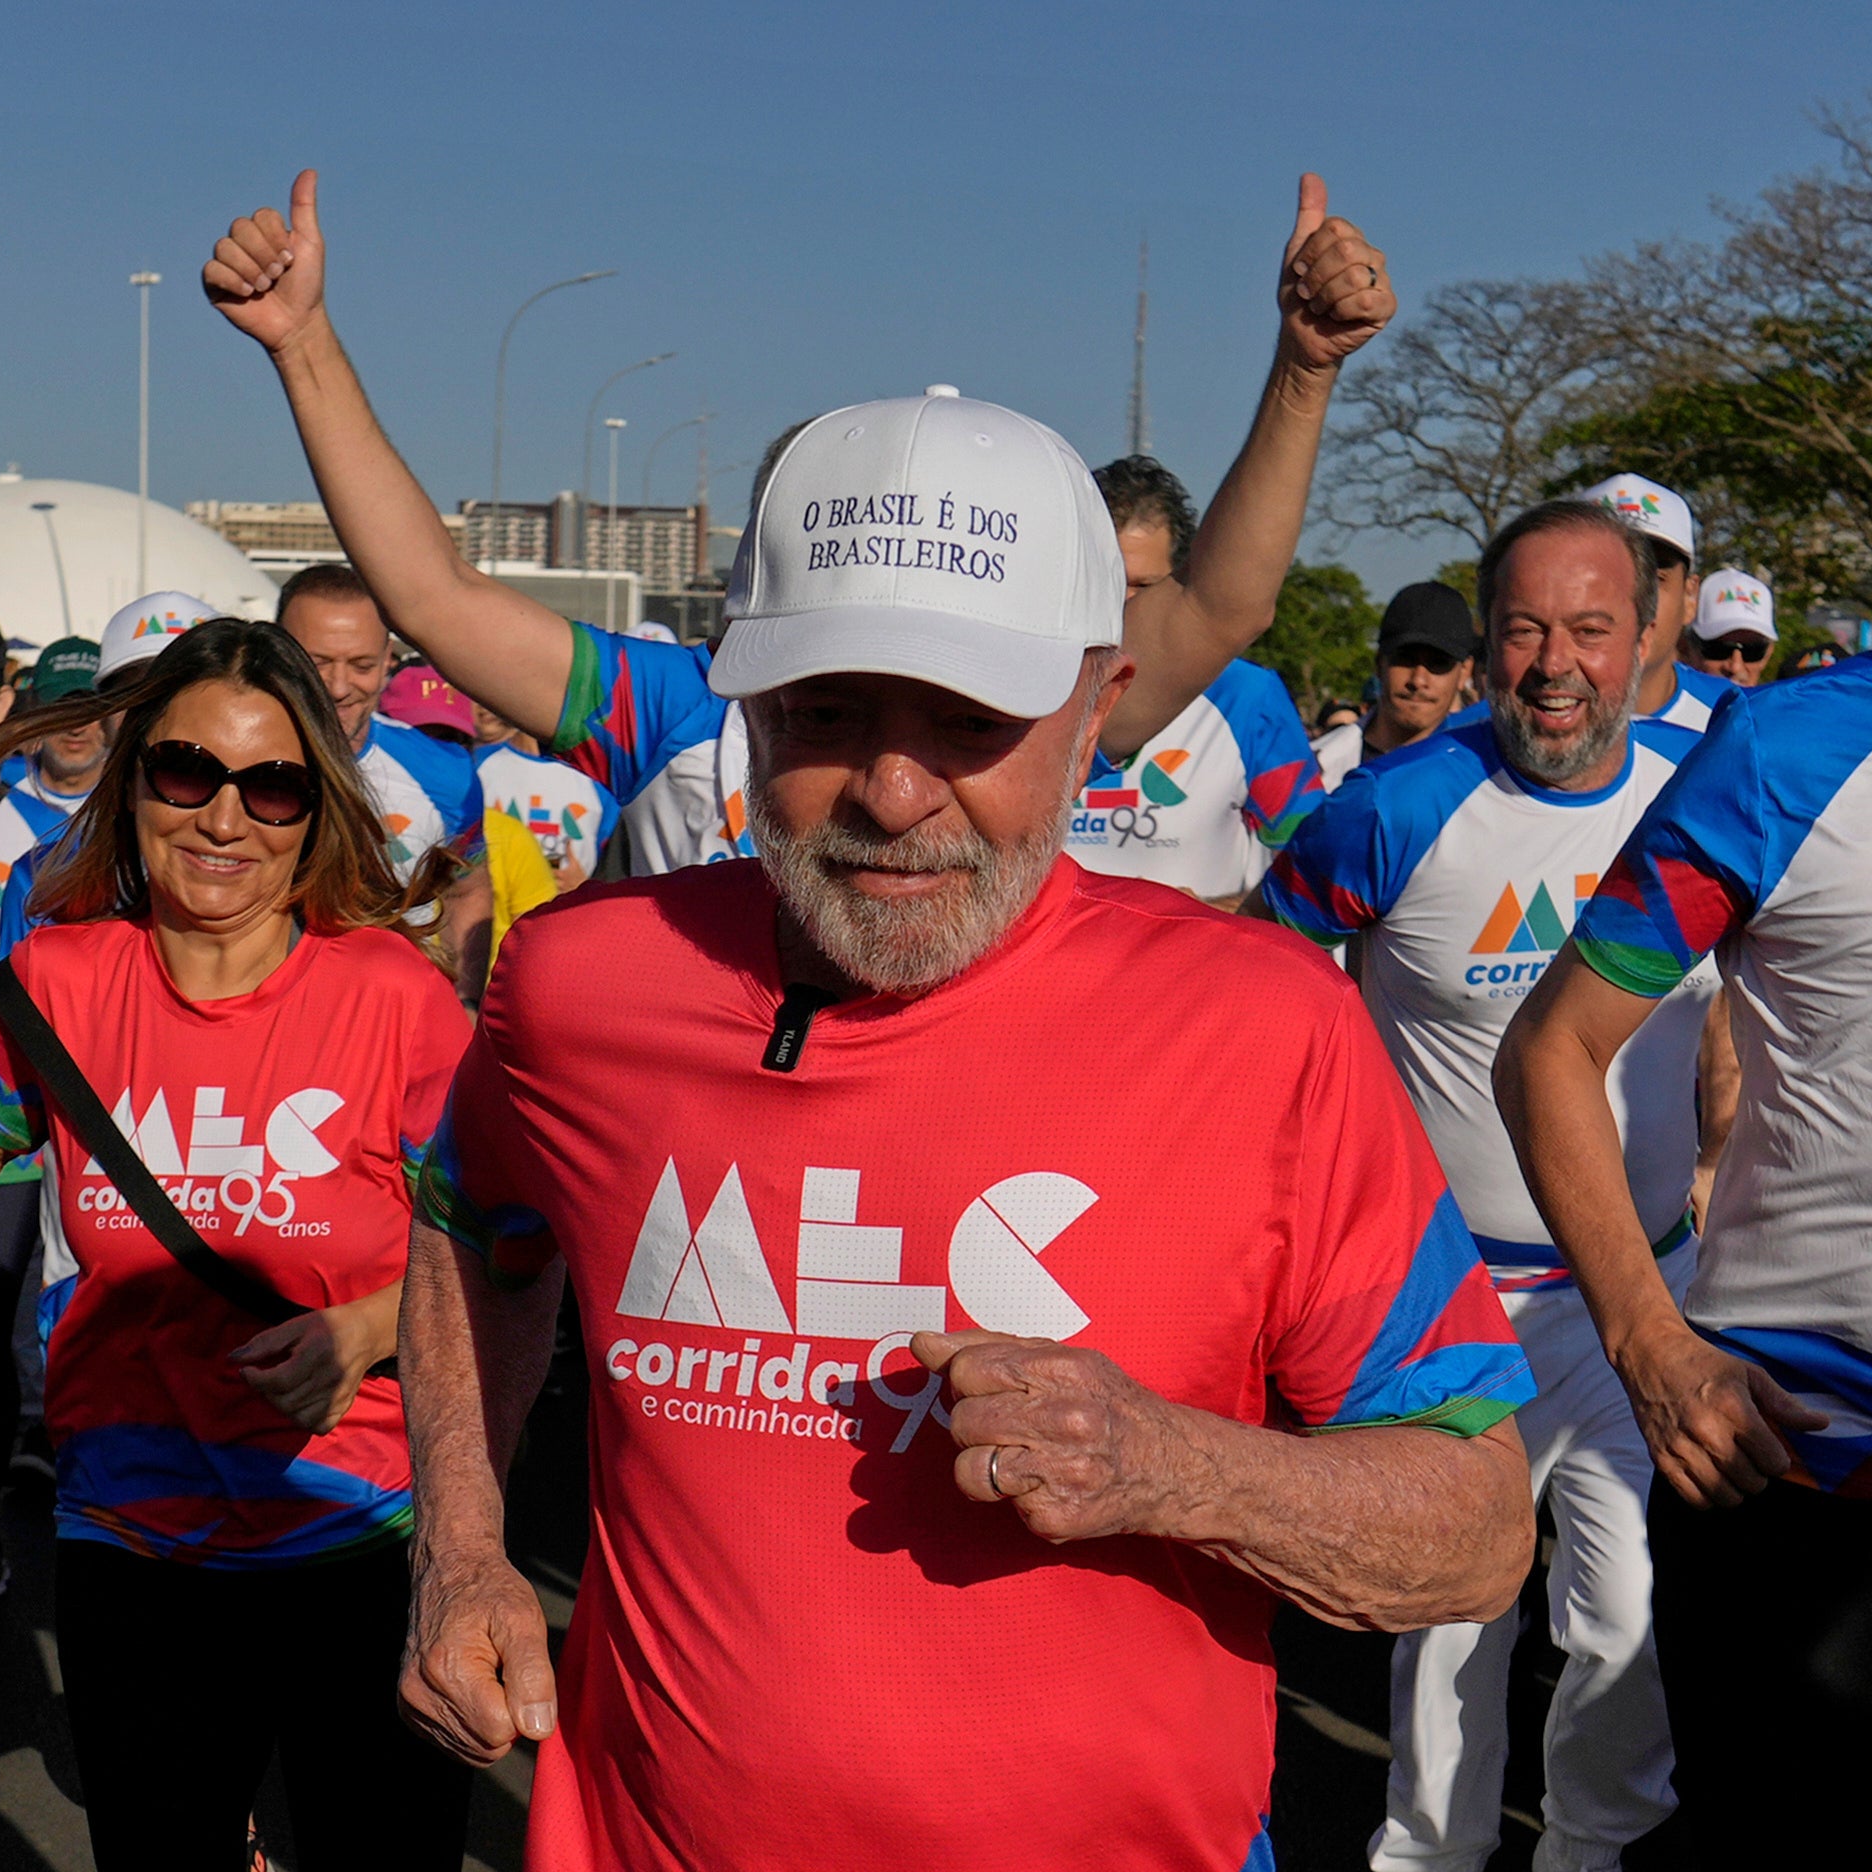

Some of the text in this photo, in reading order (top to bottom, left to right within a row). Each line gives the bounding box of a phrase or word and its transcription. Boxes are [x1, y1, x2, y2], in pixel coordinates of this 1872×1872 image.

[802, 491, 1018, 545] O BRASIL É DOS
[807, 535, 1006, 583] BRASILEIROS
[1110, 804, 1162, 848] 95
[1464, 953, 1558, 986] corr
[95, 1215, 107, 1229] e
[278, 1220, 331, 1238] anos
[218, 1169, 302, 1237] 95
[614, 1153, 1101, 1342] MEC
[605, 1331, 951, 1453] corrida 9
[640, 1392, 863, 1443] e caminhada
